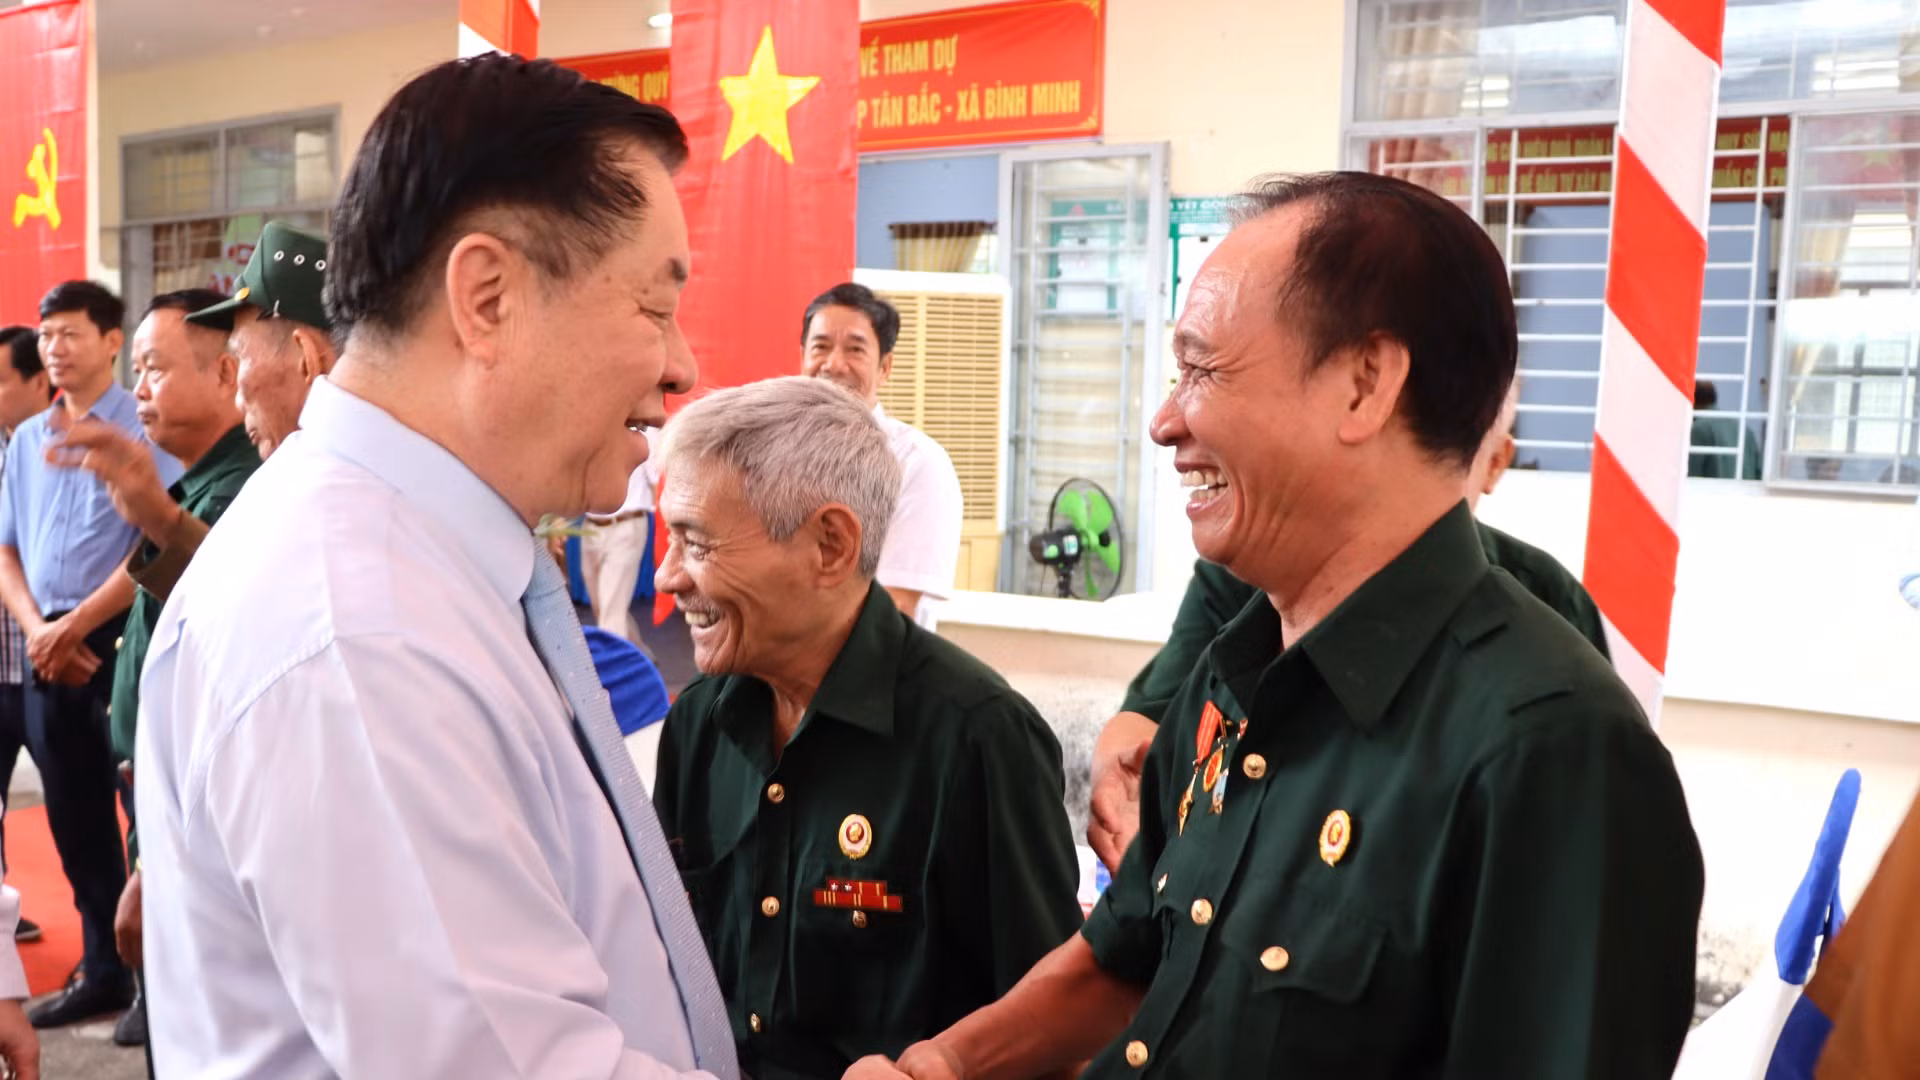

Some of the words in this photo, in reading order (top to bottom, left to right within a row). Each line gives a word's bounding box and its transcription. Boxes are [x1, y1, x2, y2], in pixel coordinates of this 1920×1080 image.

[883, 41, 928, 75] THAM
[933, 33, 958, 76] DỰ
[871, 90, 903, 128] TÂN
[907, 81, 941, 126] BẮC
[956, 82, 980, 121] XÃ
[984, 80, 1026, 119] BÌNH
[1031, 79, 1081, 115] MINH
